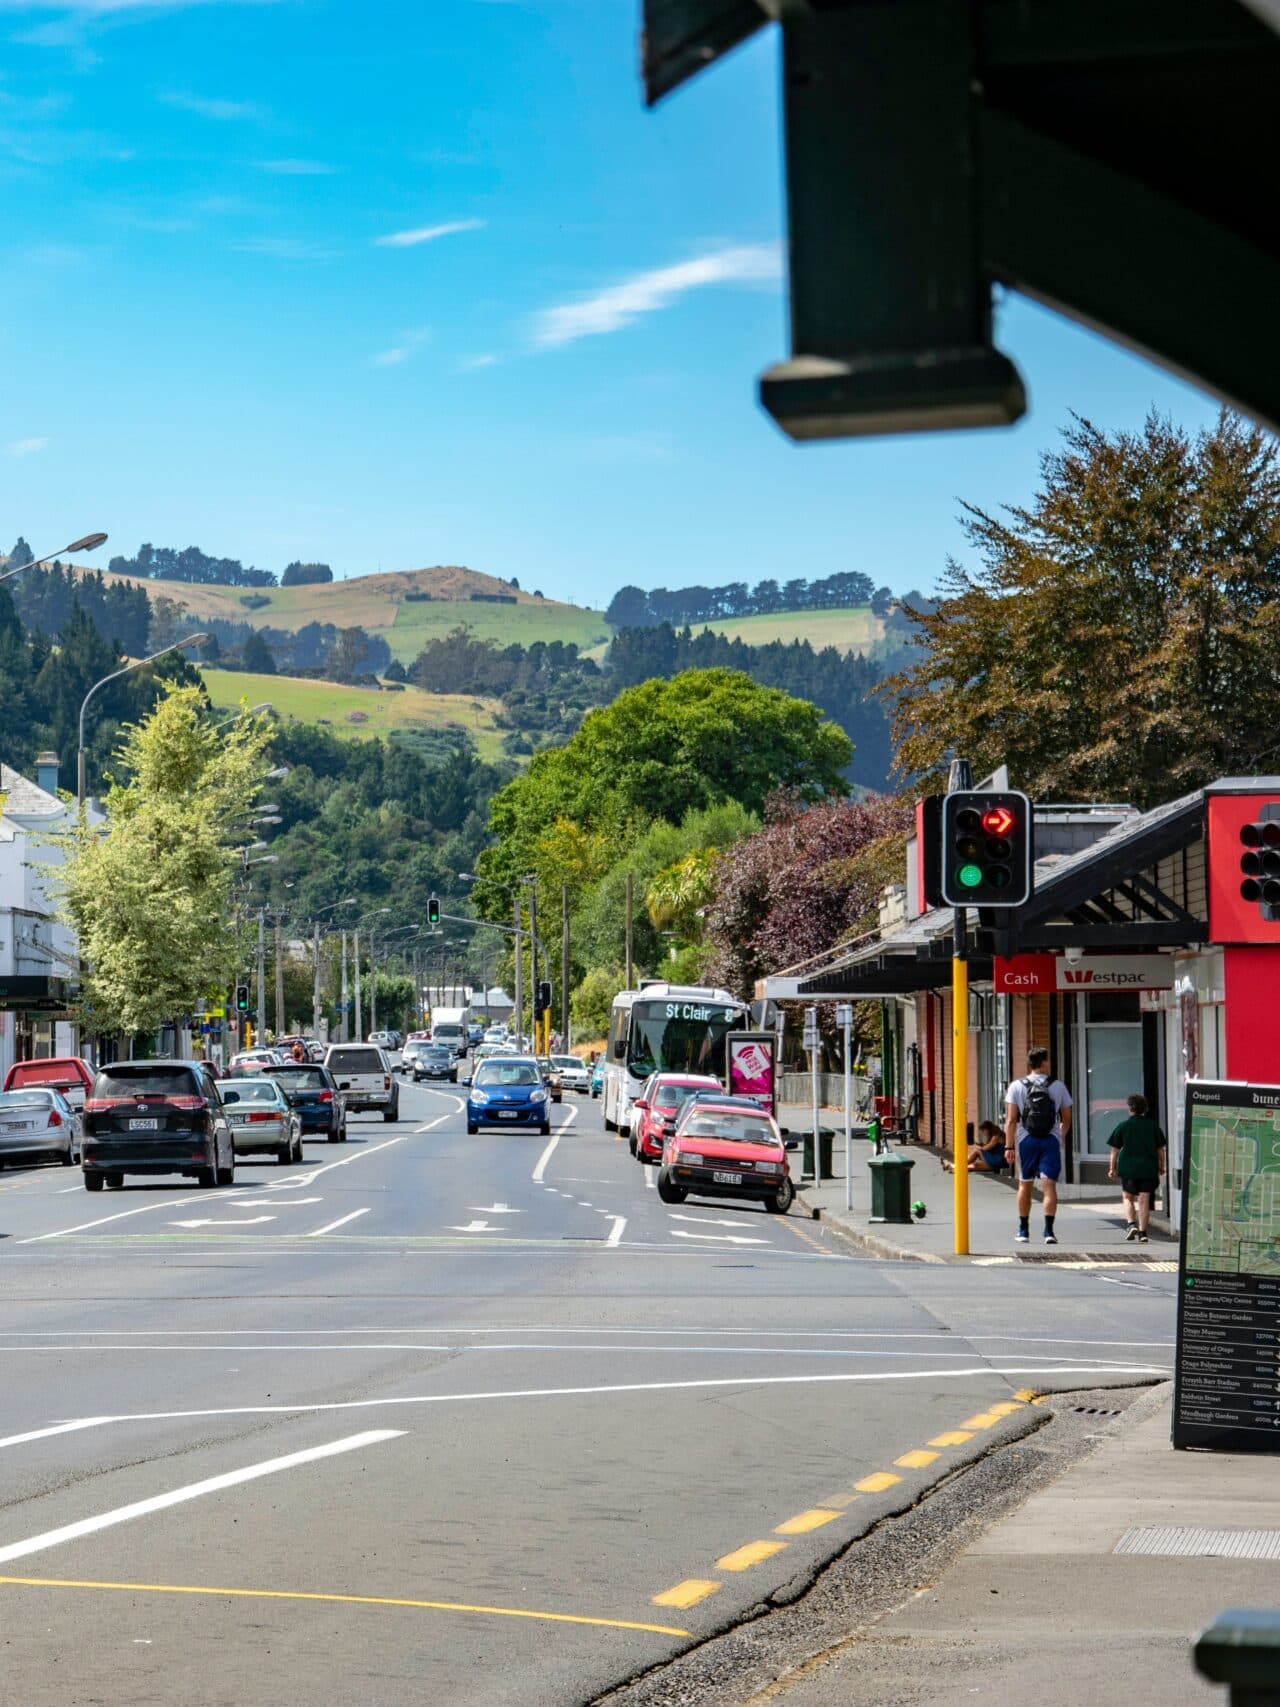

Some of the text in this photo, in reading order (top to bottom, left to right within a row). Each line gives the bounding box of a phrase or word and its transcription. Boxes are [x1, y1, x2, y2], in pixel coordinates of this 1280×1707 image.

[1004, 970, 1145, 985] Cash Westpac
[666, 1004, 733, 1022] St Clair 8
